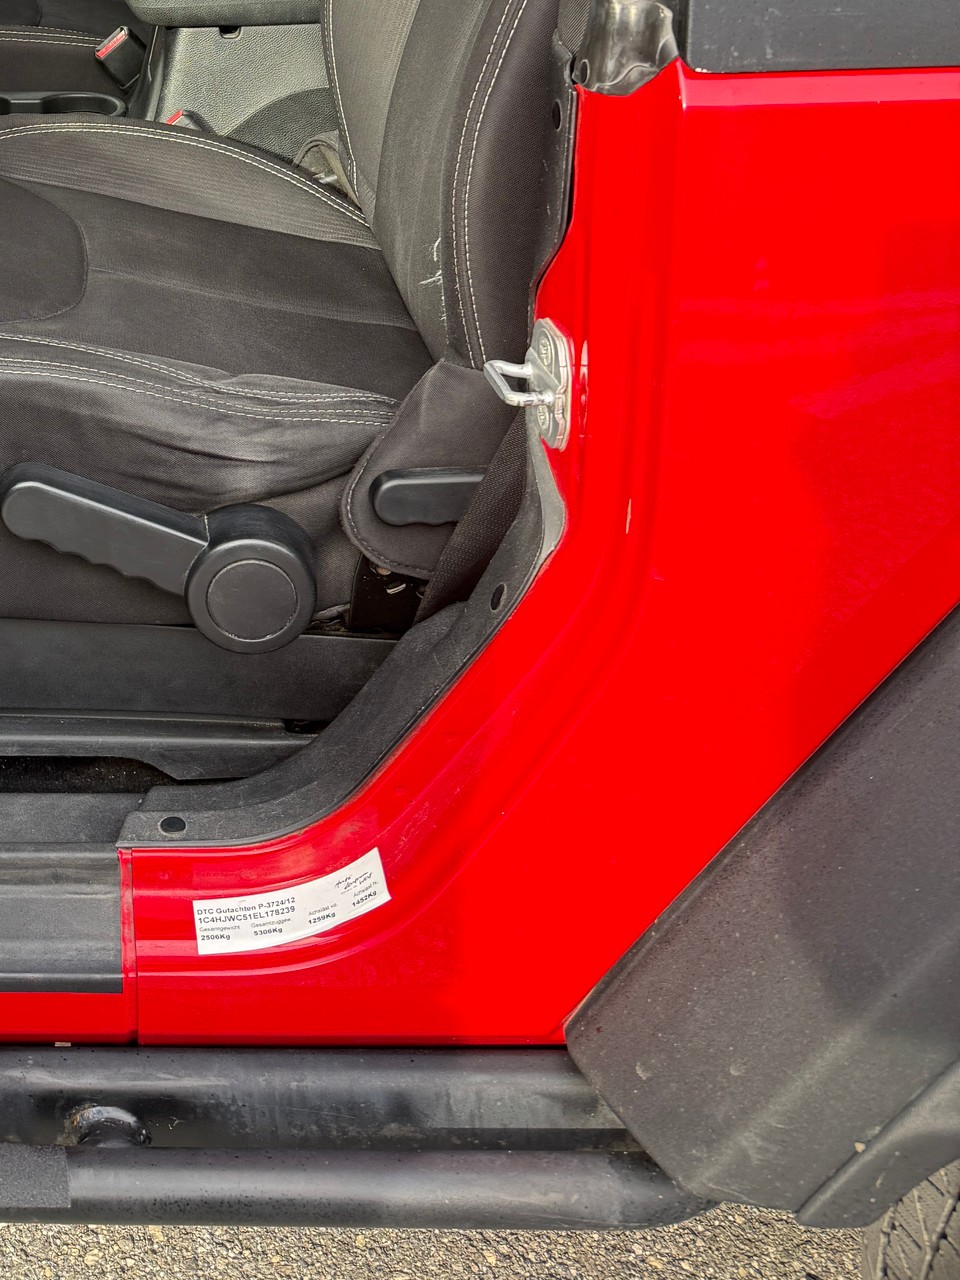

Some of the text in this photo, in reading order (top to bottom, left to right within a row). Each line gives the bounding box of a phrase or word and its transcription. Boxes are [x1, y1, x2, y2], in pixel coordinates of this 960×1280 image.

[352, 890, 377, 907] 1452Kg
[196, 897, 296, 916] DTC Gutachten P-3724/12
[198, 905, 296, 924] 1C4HJWC51EL178239
[308, 912, 336, 925] 1259Kg
[200, 933, 231, 941] 2506Kg
[253, 927, 283, 936] 5306Kg
